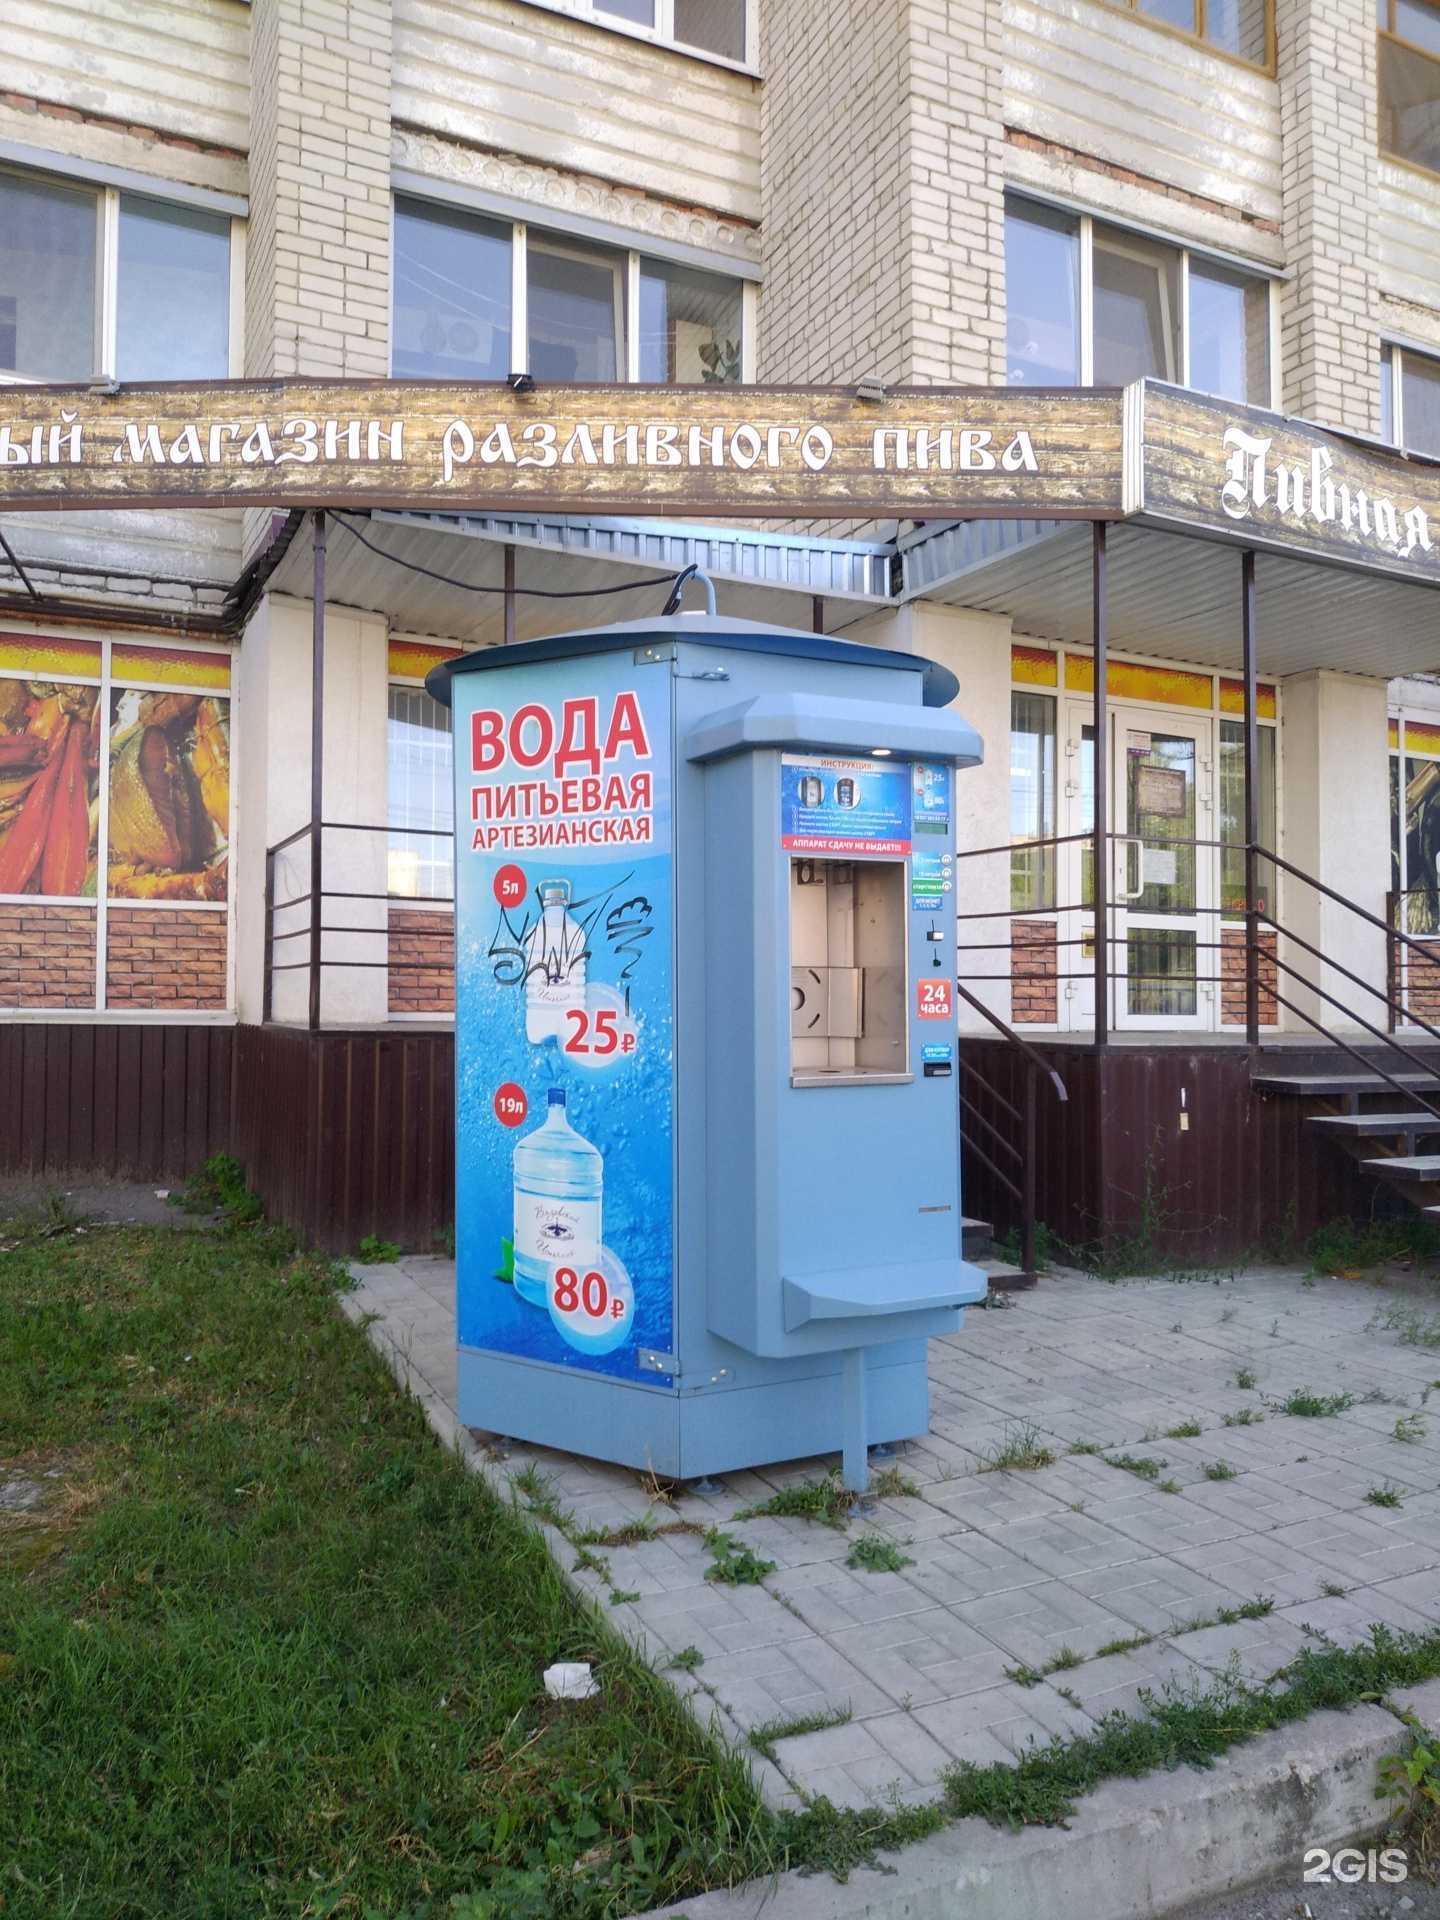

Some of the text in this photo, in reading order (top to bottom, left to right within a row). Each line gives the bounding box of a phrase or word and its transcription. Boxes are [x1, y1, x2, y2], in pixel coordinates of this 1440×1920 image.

[113, 420, 403, 465] магазин
[444, 420, 834, 481] разливного
[872, 428, 1038, 471] пива
[1222, 427, 1434, 557] Пивная
[471, 691, 650, 779] ВОДА
[471, 772, 651, 820] ПИТЬЕВАЯ
[472, 816, 651, 849] АРТЕЗИАНСКАЯ
[792, 839, 828, 849] АППАРАТ
[828, 840, 854, 851] СДАЧУ
[854, 842, 865, 850] НЕ
[502, 879, 519, 894] 5л
[923, 985, 946, 1002] 24
[920, 1003, 949, 1014] часа
[499, 1097, 524, 1114] 19л
